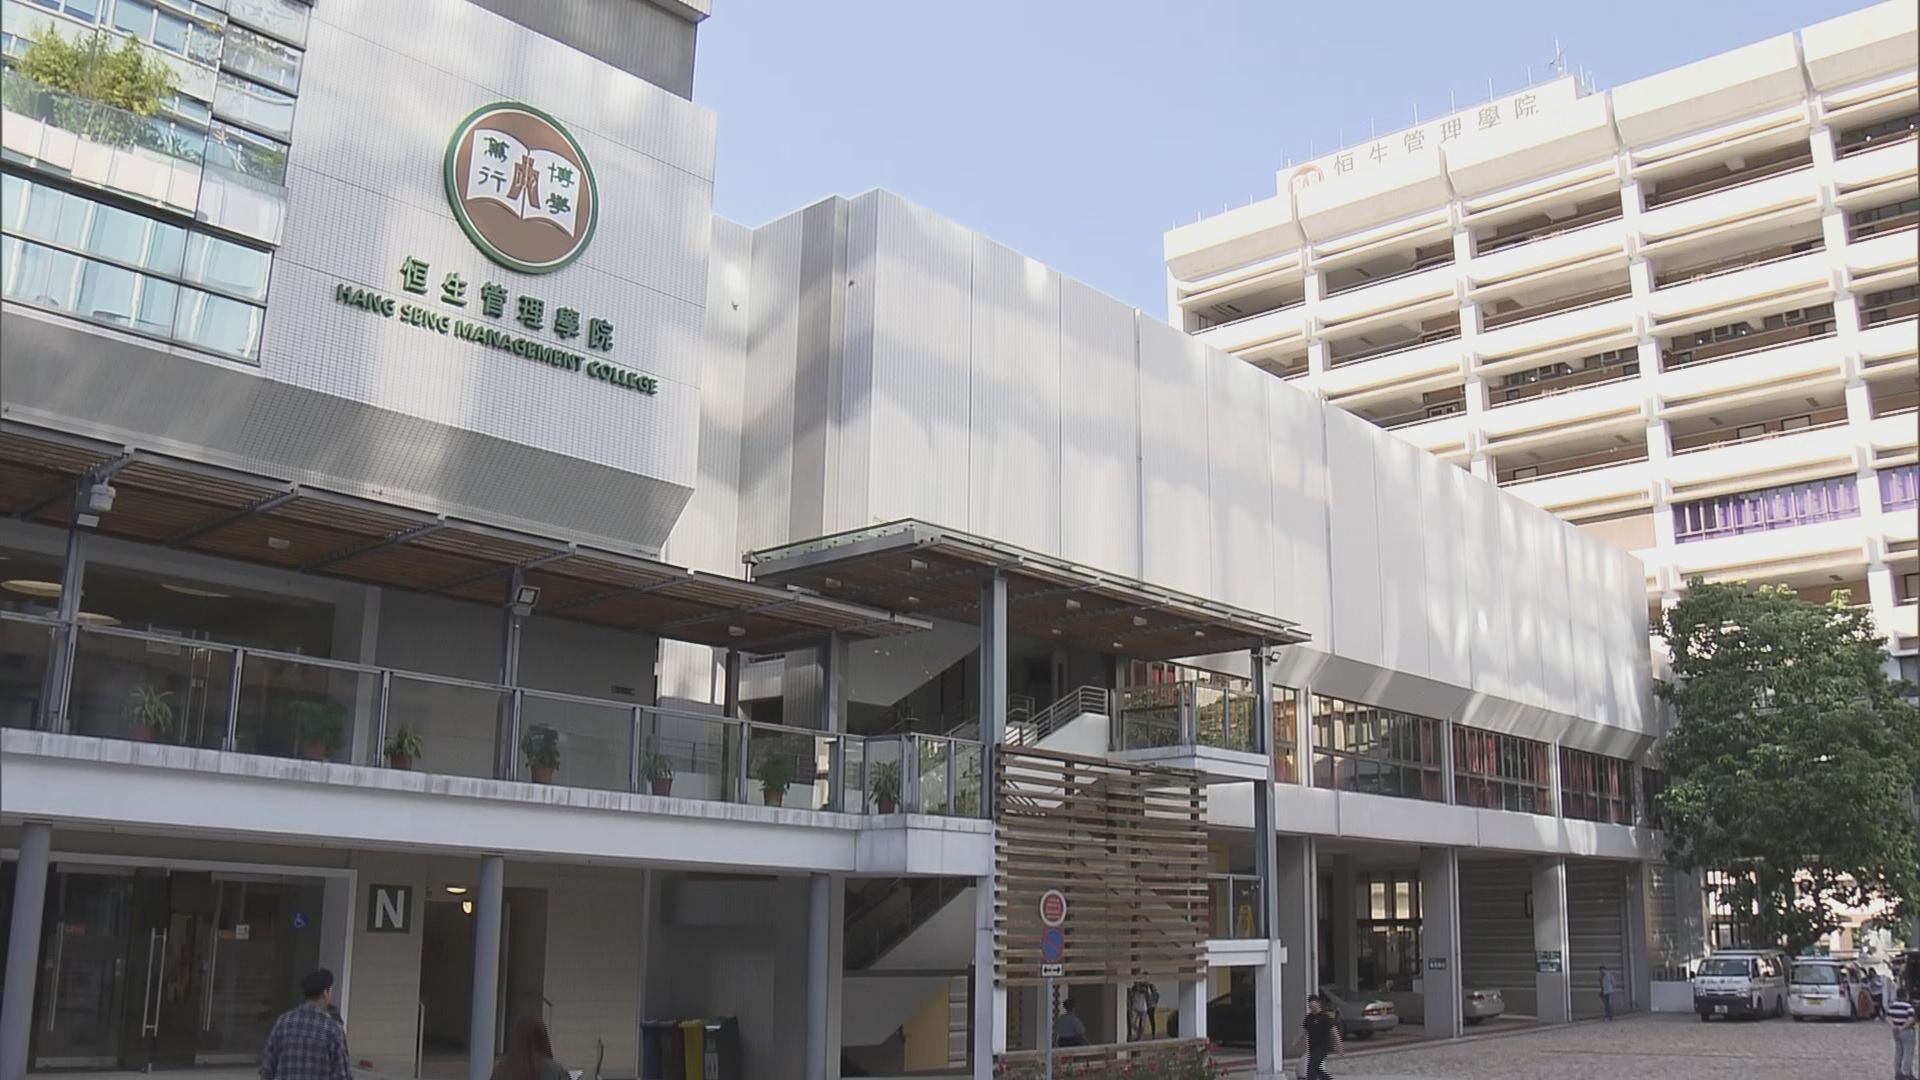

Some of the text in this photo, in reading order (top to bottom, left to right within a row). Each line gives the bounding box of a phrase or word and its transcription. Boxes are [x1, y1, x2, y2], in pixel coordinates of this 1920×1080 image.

[335, 283, 658, 396] HANG SENG MANAGEMENT COLLEGE
[400, 256, 614, 352] 恒生管理學院
[375, 888, 405, 929] N
